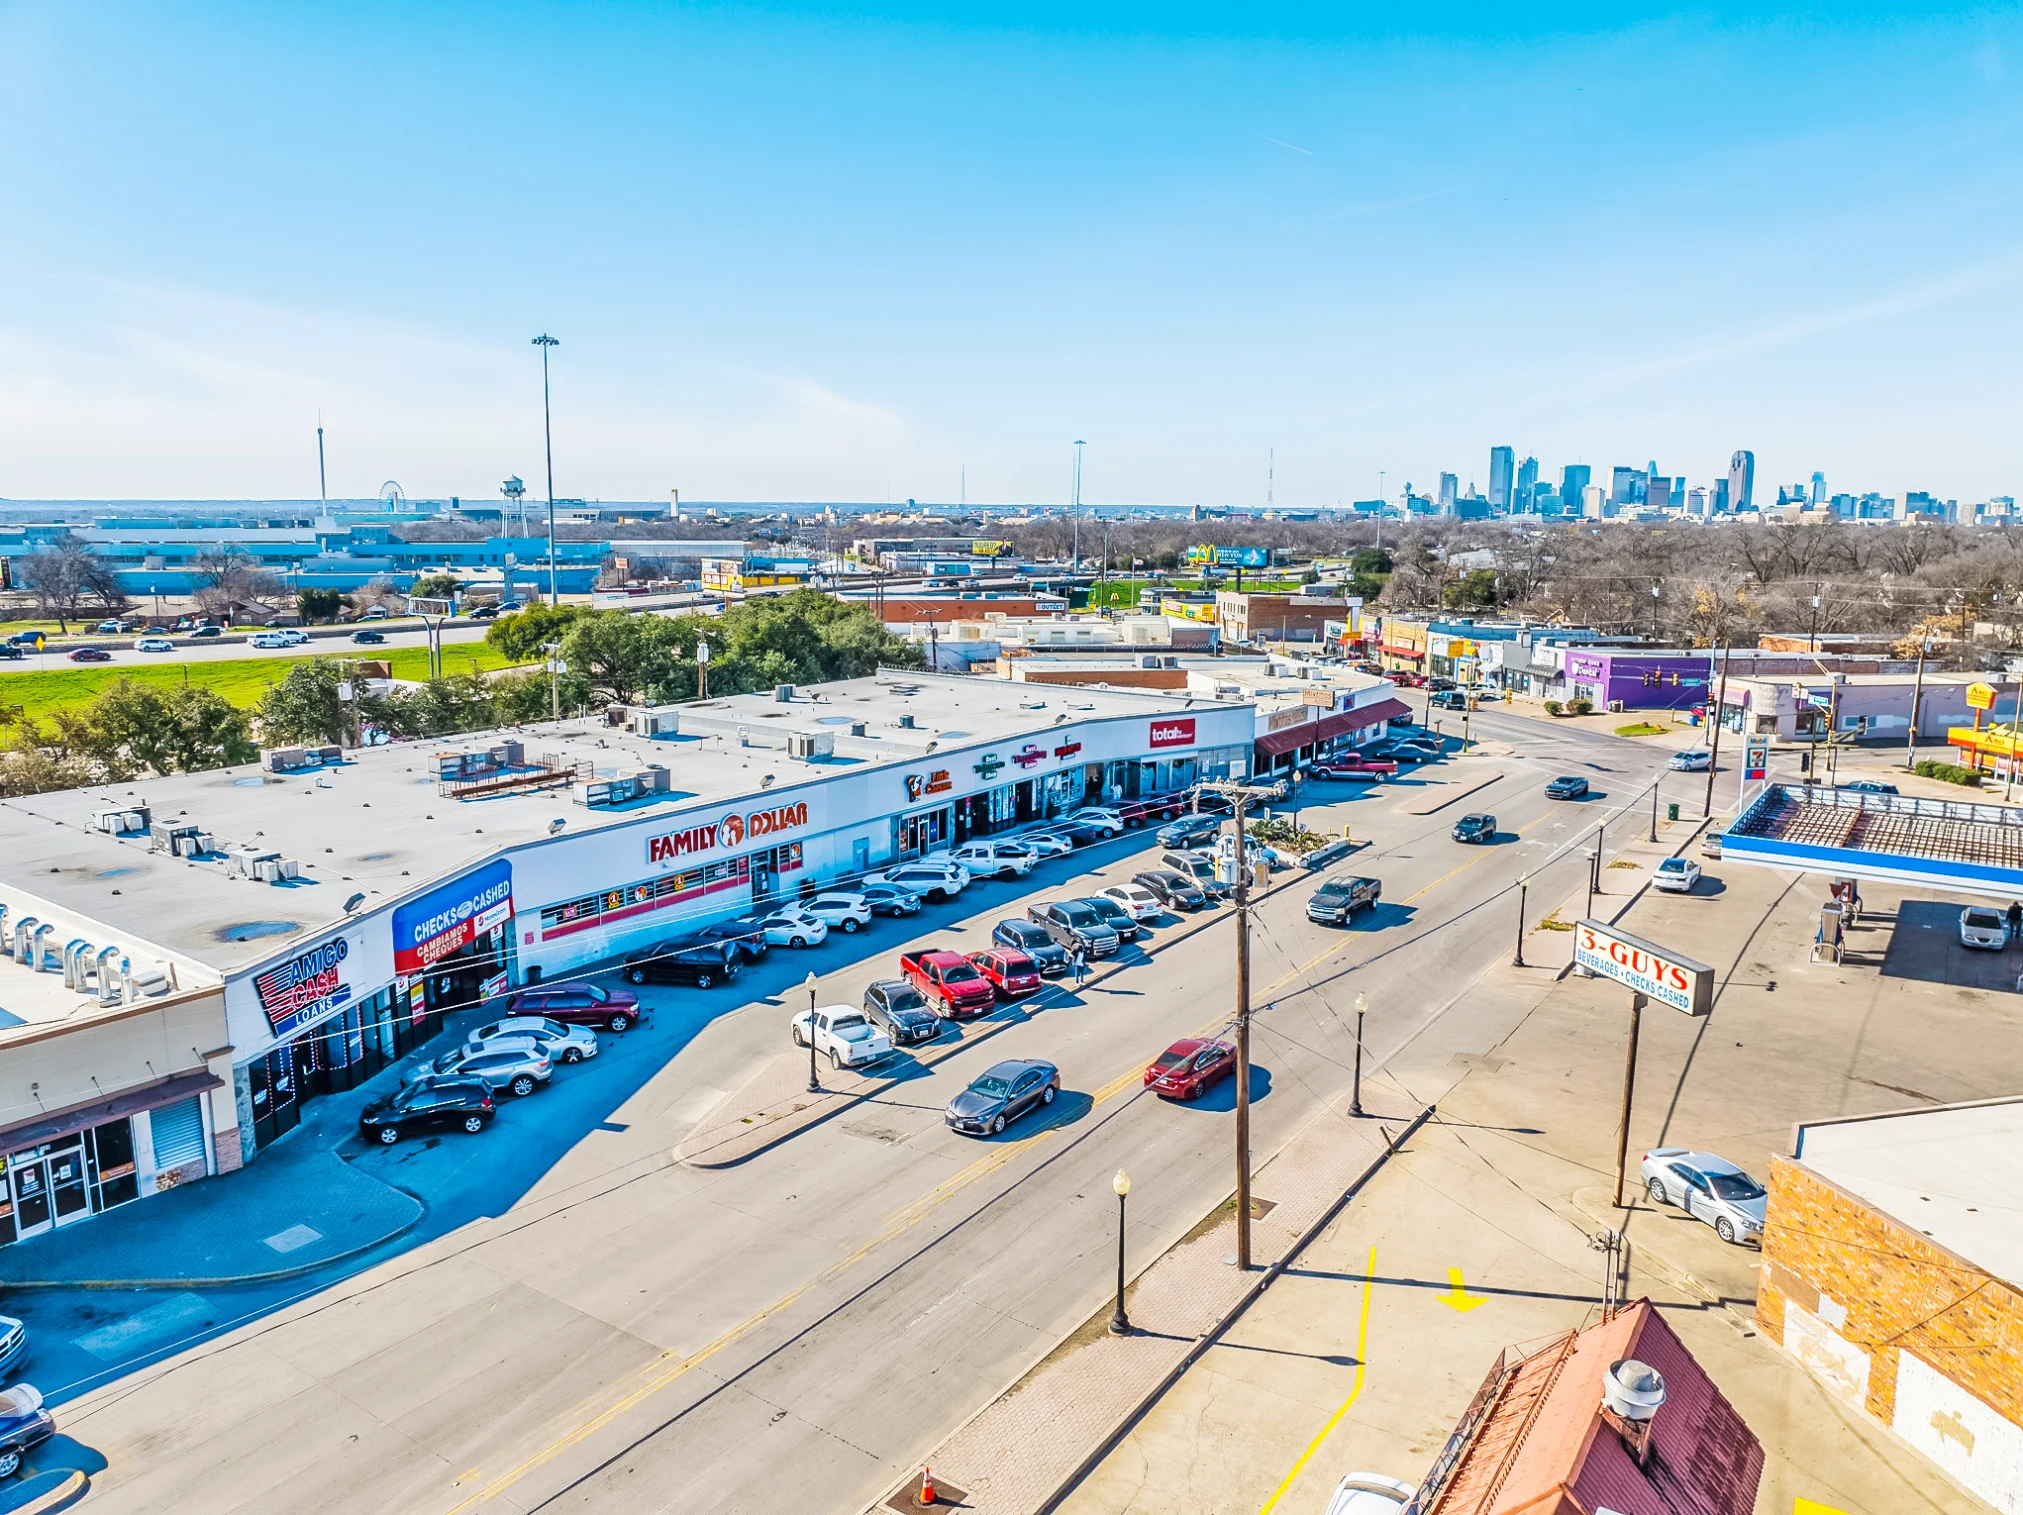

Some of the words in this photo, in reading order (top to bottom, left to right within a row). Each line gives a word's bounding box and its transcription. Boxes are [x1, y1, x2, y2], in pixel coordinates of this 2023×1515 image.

[1304, 690, 1332, 699] Mixtitos
[1152, 726, 1176, 741] total
[984, 771, 997, 780] Shop
[650, 823, 719, 863] FAMILY
[750, 801, 808, 838] DOLLAR
[414, 907, 458, 943] CHECKS
[473, 880, 510, 912] CASHED
[417, 922, 468, 958] CAMBIAMOS
[423, 936, 463, 964] CHEQUES
[1580, 929, 1688, 990] 3-GUYS
[289, 939, 349, 987] AMIGO
[1577, 948, 1619, 977] BEVERAGES
[1625, 970, 1656, 995] CHECKS
[1657, 984, 1690, 1009] CASHED
[291, 966, 339, 1009] CASH
[295, 996, 334, 1026] LOANS
